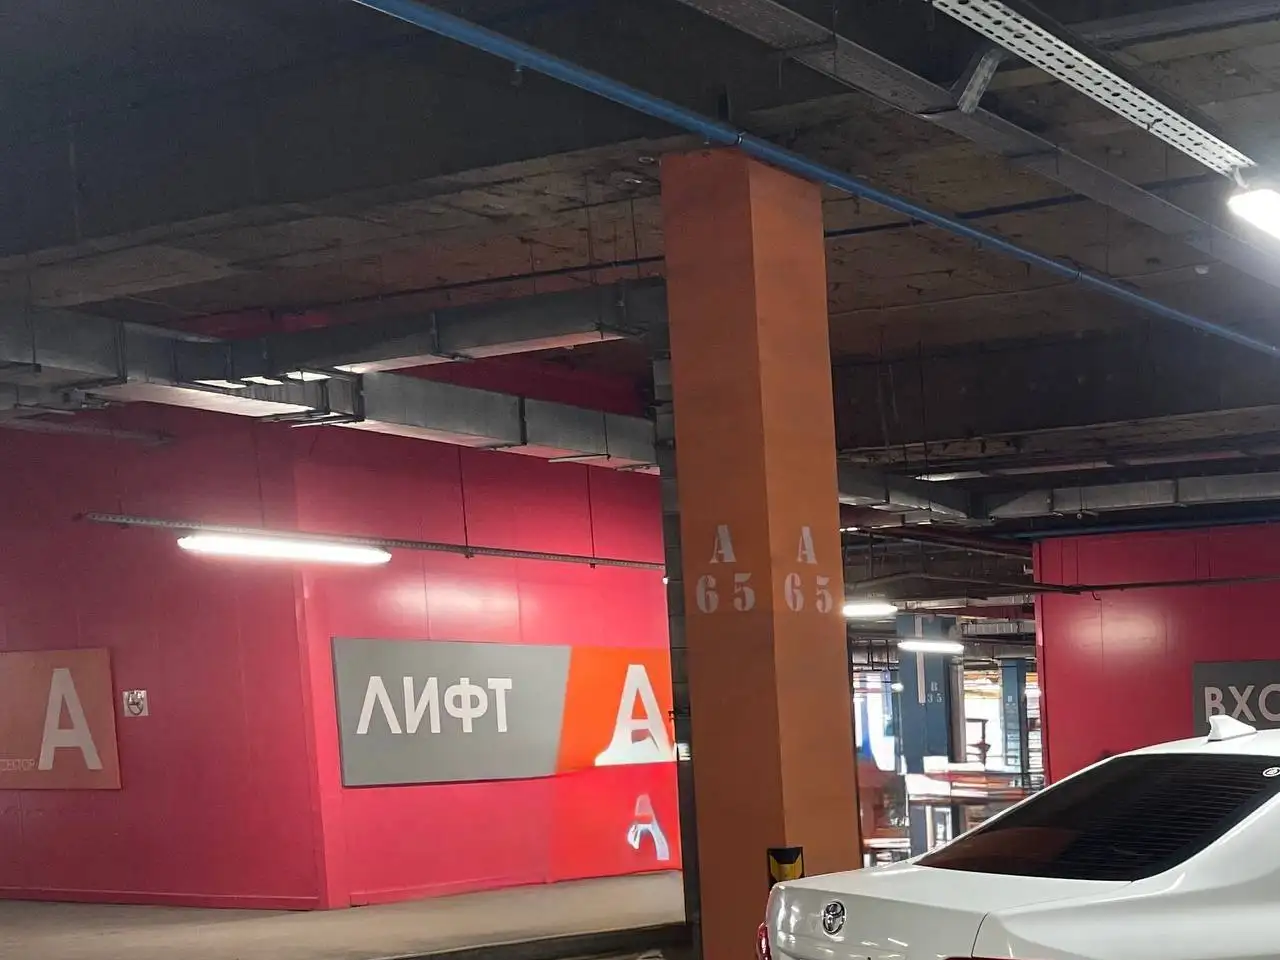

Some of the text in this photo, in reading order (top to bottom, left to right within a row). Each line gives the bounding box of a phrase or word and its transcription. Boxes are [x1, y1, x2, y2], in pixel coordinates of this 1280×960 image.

[709, 525, 737, 563] А
[796, 526, 818, 564] А
[696, 573, 756, 614] 65
[784, 573, 833, 614] 65
[38, 667, 103, 770] А
[356, 675, 513, 735] ЛИФТ
[595, 664, 677, 766] А
